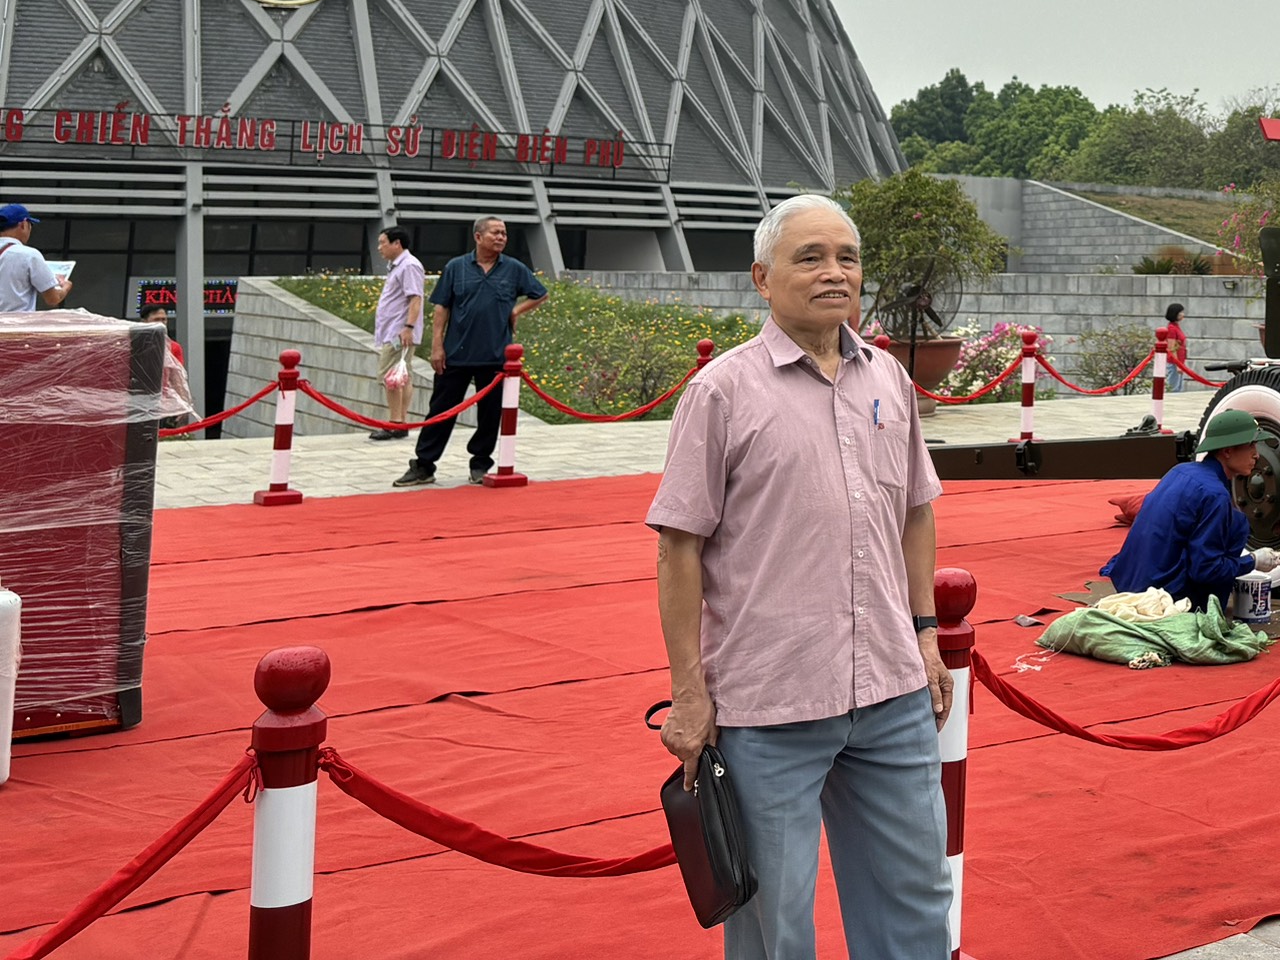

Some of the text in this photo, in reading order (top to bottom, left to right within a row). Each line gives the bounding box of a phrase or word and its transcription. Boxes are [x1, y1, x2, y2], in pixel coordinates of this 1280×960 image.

[54, 101, 150, 145] CHIẾN
[176, 102, 276, 150] THẮNG
[300, 120, 364, 159] LỊCH
[386, 113, 423, 157] SỬ
[516, 128, 568, 164] BIÊN
[584, 130, 624, 168] PHỦ
[145, 286, 177, 304] KÍN
